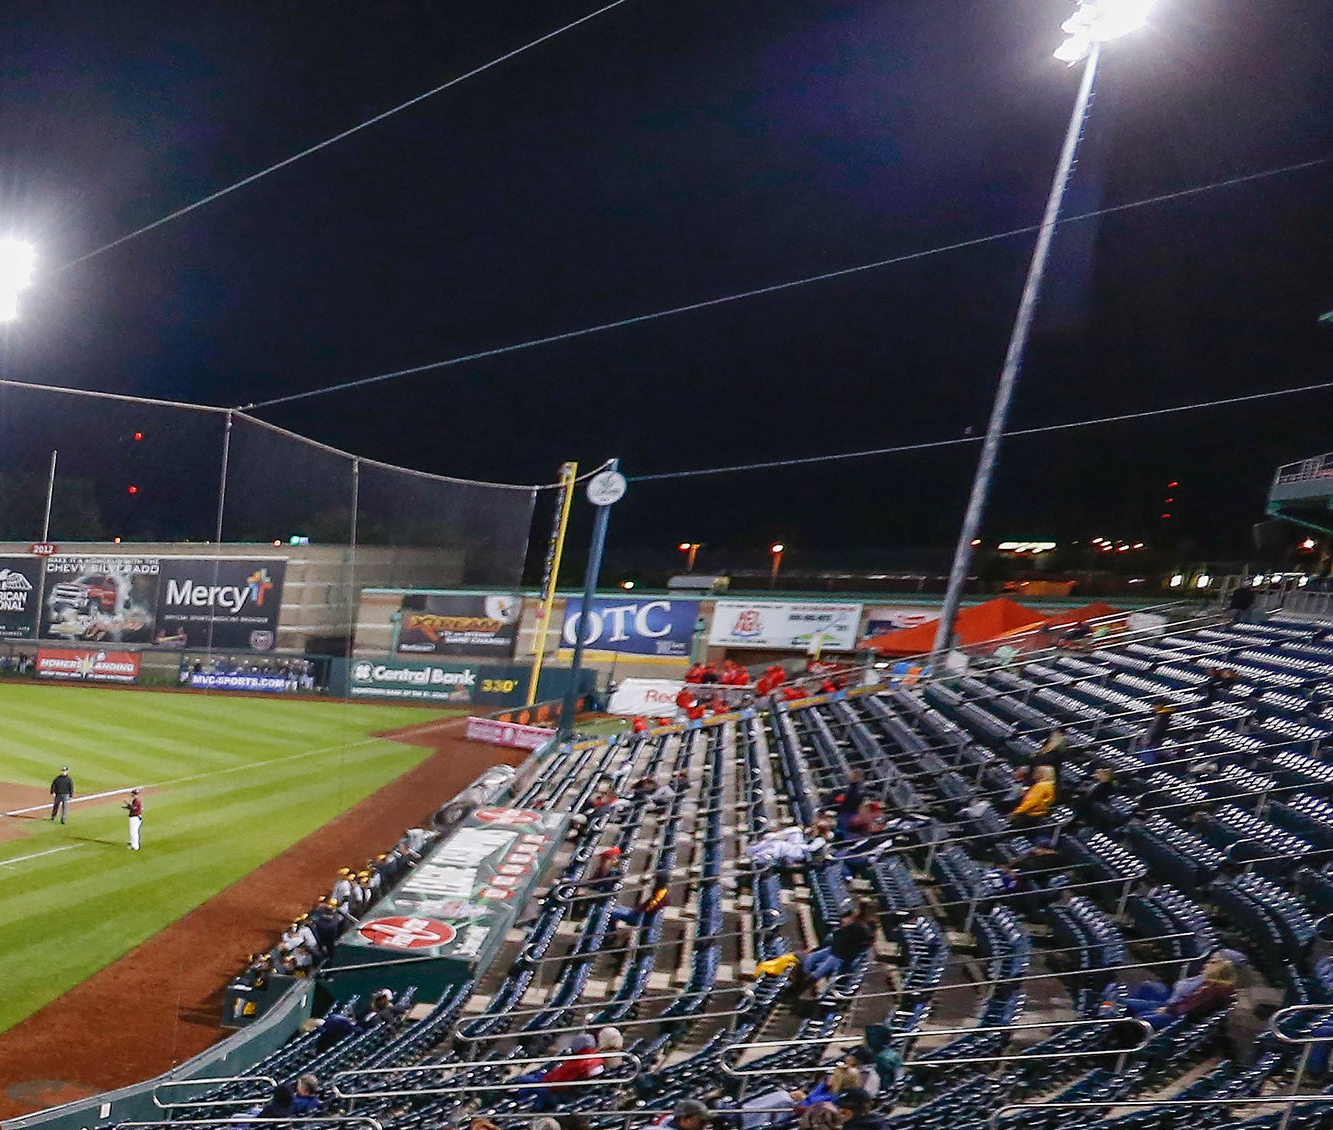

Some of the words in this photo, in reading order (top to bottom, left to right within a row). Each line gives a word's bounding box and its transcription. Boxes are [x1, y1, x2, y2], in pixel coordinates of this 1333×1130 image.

[47, 563, 86, 572] CHEVY
[165, 579, 250, 613] Mercy
[563, 601, 672, 646] OTC
[373, 665, 431, 684] Central
[432, 669, 476, 685] Bank
[482, 679, 518, 694] 330'
